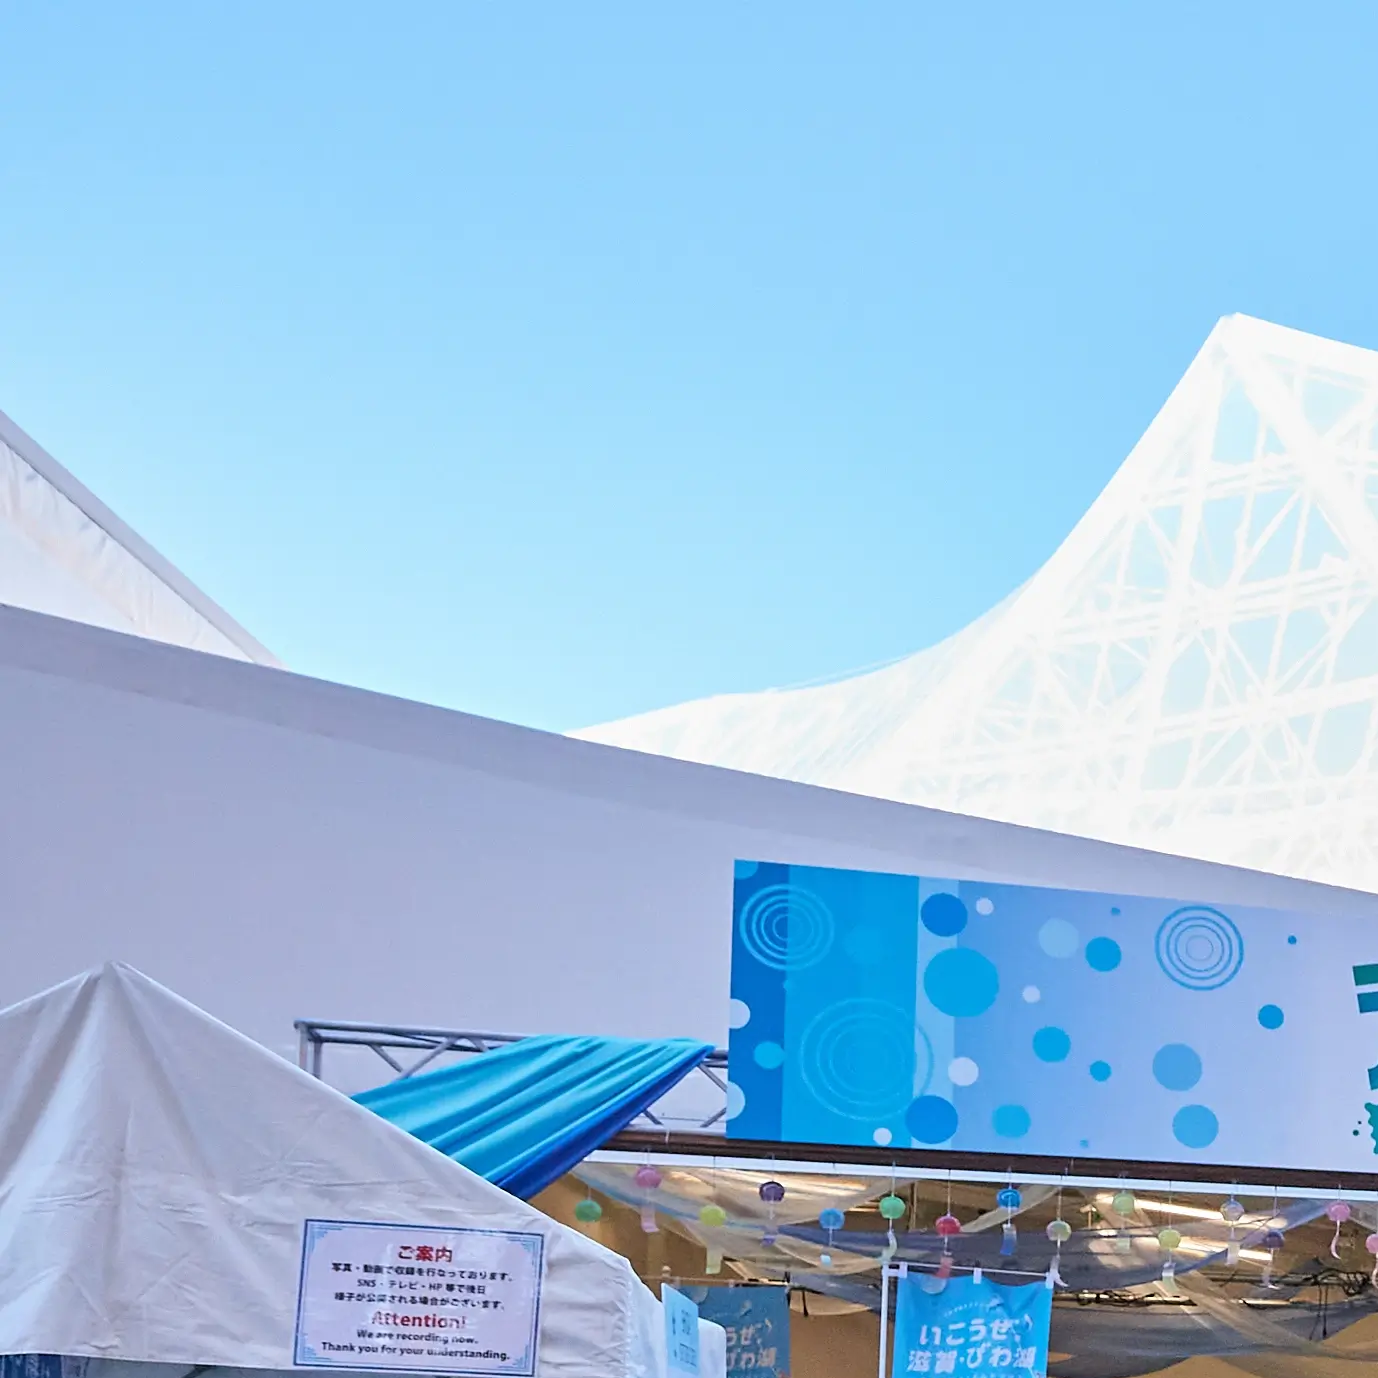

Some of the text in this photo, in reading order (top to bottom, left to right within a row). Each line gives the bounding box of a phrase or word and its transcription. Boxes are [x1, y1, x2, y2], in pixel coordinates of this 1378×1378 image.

[398, 1245, 453, 1263] ご案内
[371, 1310, 466, 1329] Attention!
[357, 1329, 373, 1339] We
[376, 1331, 394, 1340] are
[396, 1332, 448, 1344] recording
[322, 1342, 511, 1362] Thank you for your understanding.
